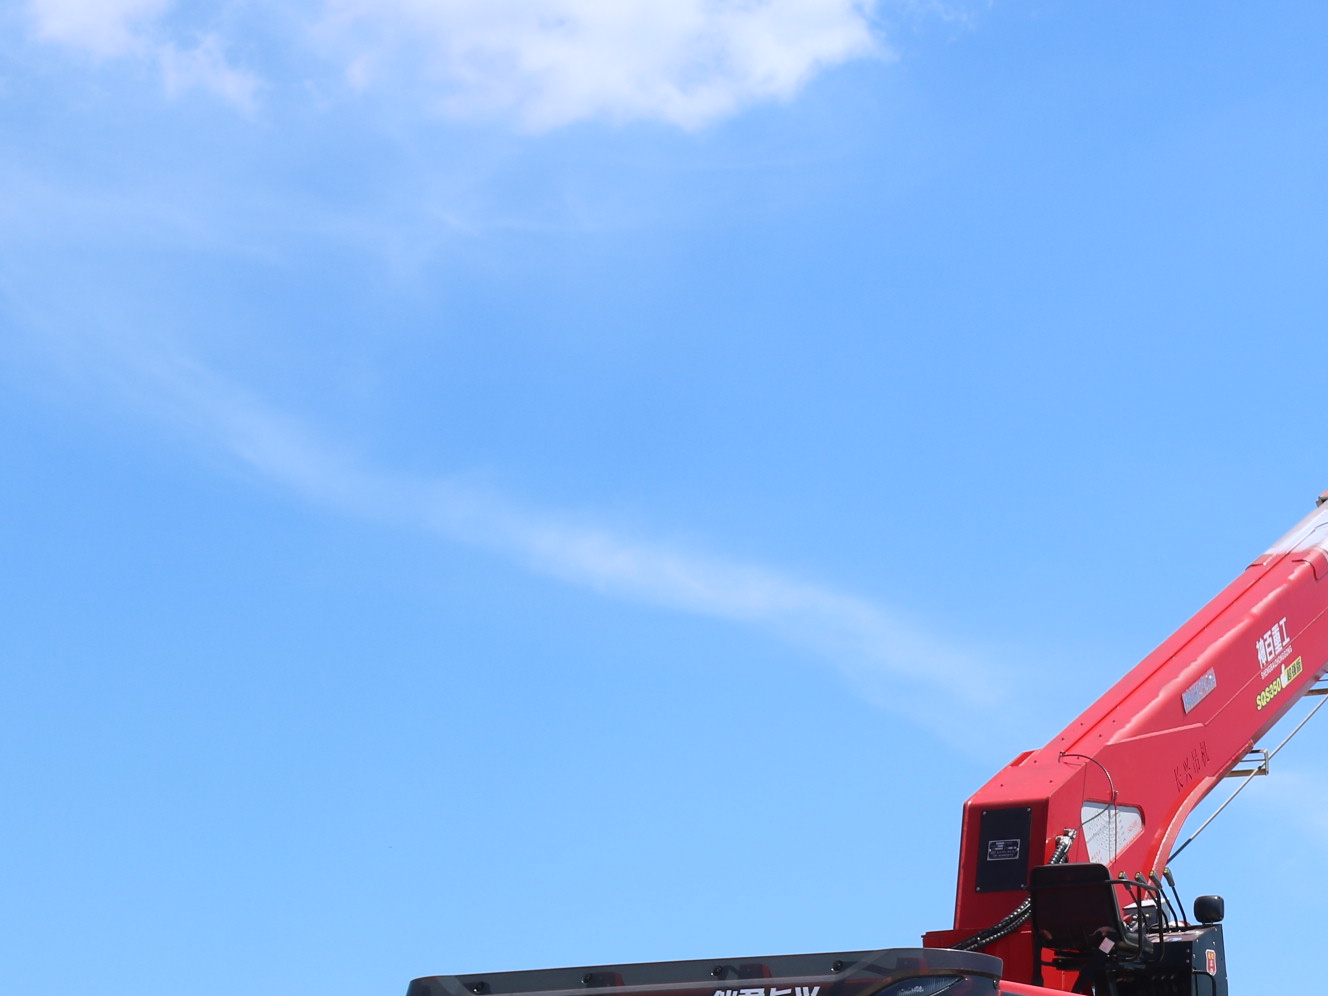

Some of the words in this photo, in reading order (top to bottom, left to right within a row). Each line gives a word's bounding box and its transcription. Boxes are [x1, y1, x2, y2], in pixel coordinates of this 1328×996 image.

[1255, 616, 1290, 669] 神百重工
[1256, 677, 1282, 711] SQS350
